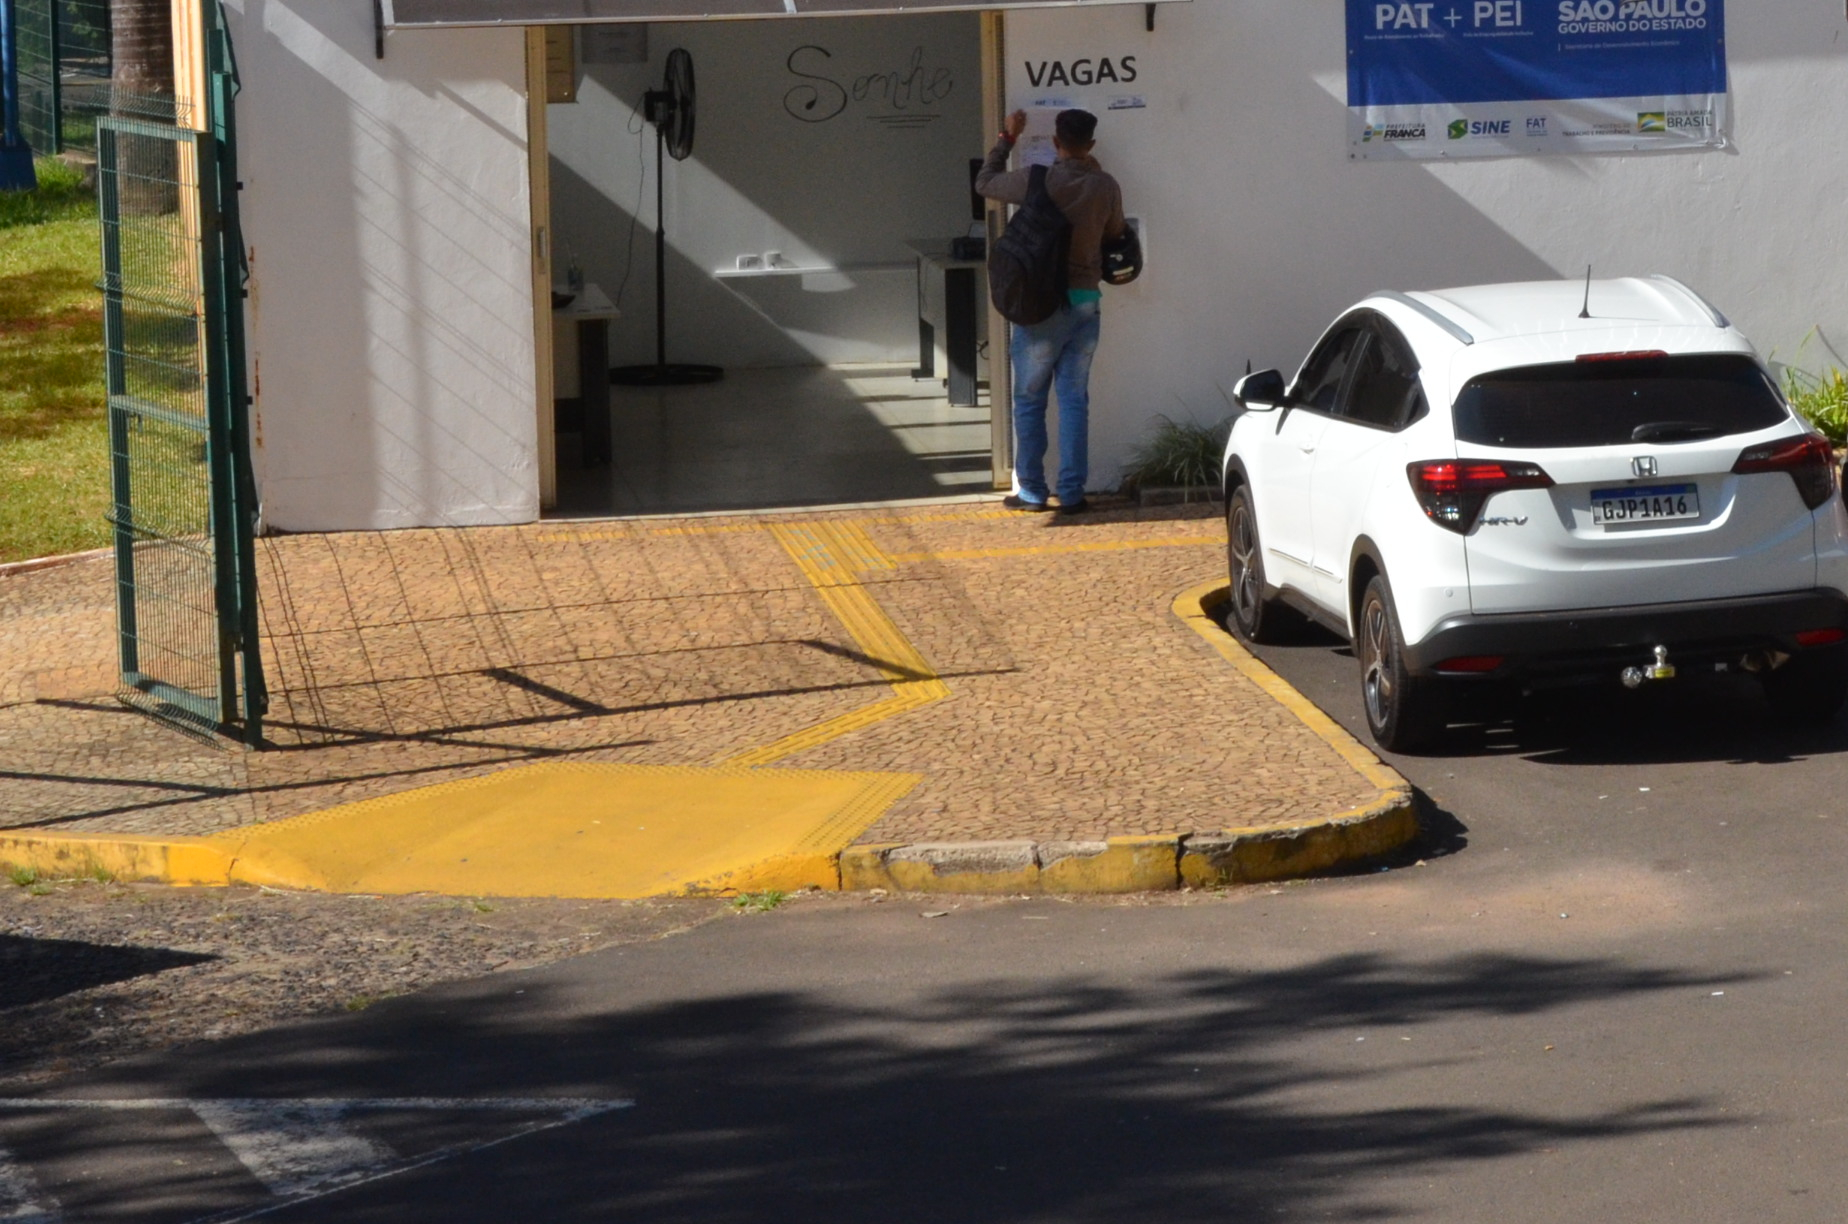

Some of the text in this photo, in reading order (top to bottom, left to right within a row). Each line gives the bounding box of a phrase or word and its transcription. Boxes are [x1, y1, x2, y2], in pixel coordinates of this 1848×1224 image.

[1376, 3, 1434, 29] PAT
[1474, 0, 1521, 26] PEI
[1558, 17, 1706, 34] GOVERNO DO ESTADO
[1024, 55, 1137, 88] VAGAS
[1471, 120, 1511, 135] SINE
[1526, 117, 1546, 128] FAT
[1667, 116, 1712, 127] BRASIL
[1384, 129, 1425, 138] FRANCA
[1602, 495, 1687, 520] GJP1A16
